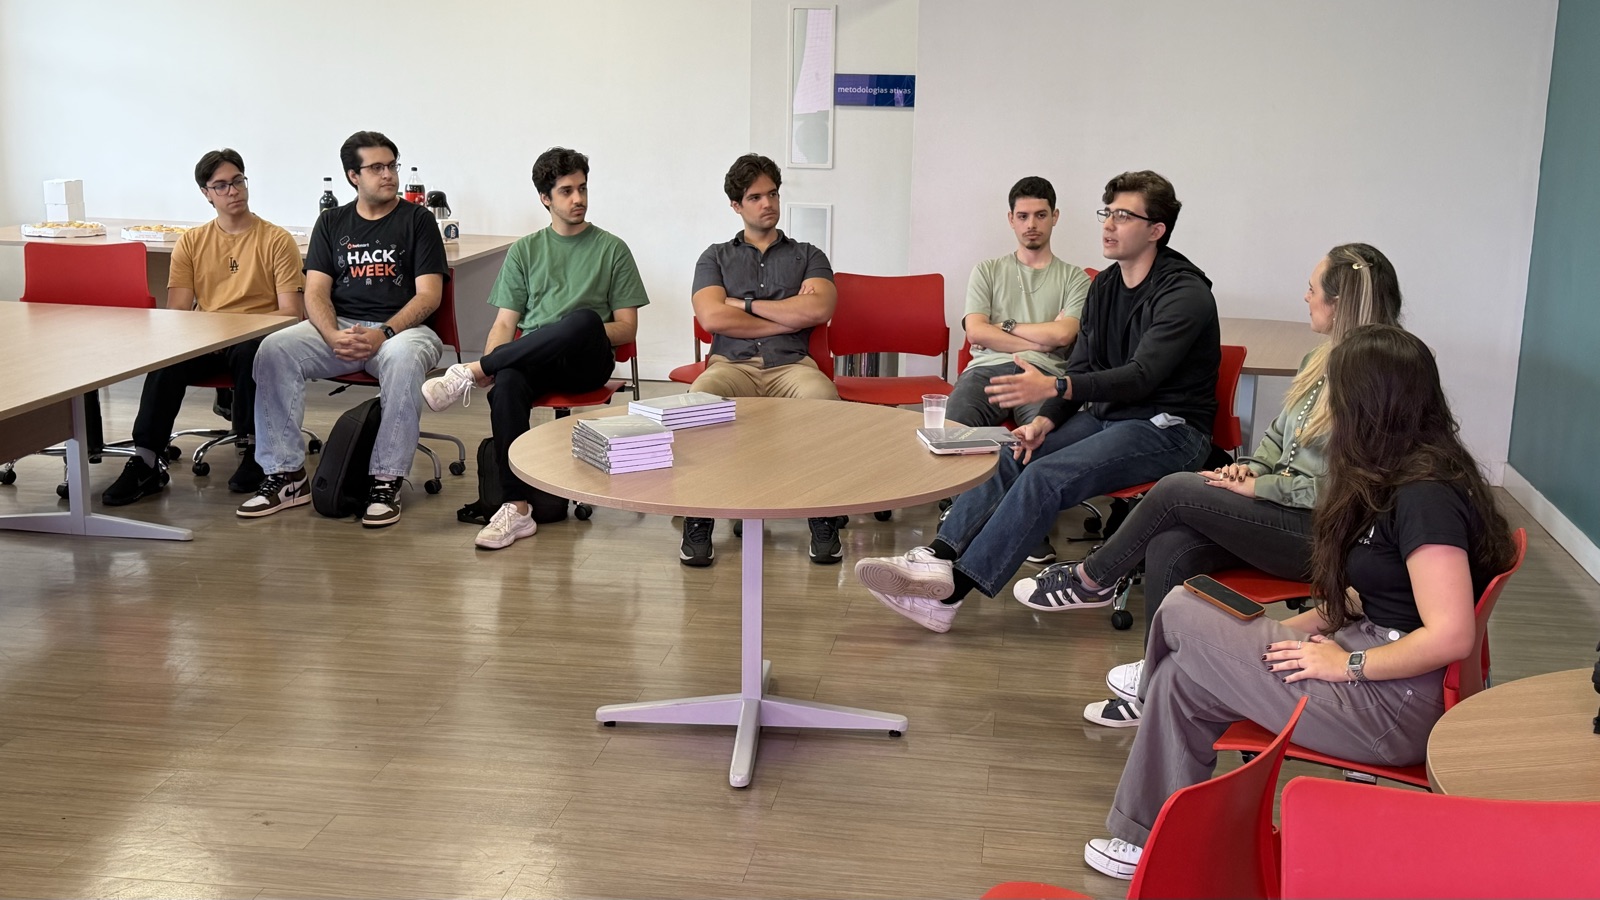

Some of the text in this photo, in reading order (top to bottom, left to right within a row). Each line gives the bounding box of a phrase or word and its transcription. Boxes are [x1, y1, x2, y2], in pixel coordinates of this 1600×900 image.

[837, 86, 888, 95] metodologias
[347, 249, 396, 265] HACK
[350, 264, 396, 278] WEEK
